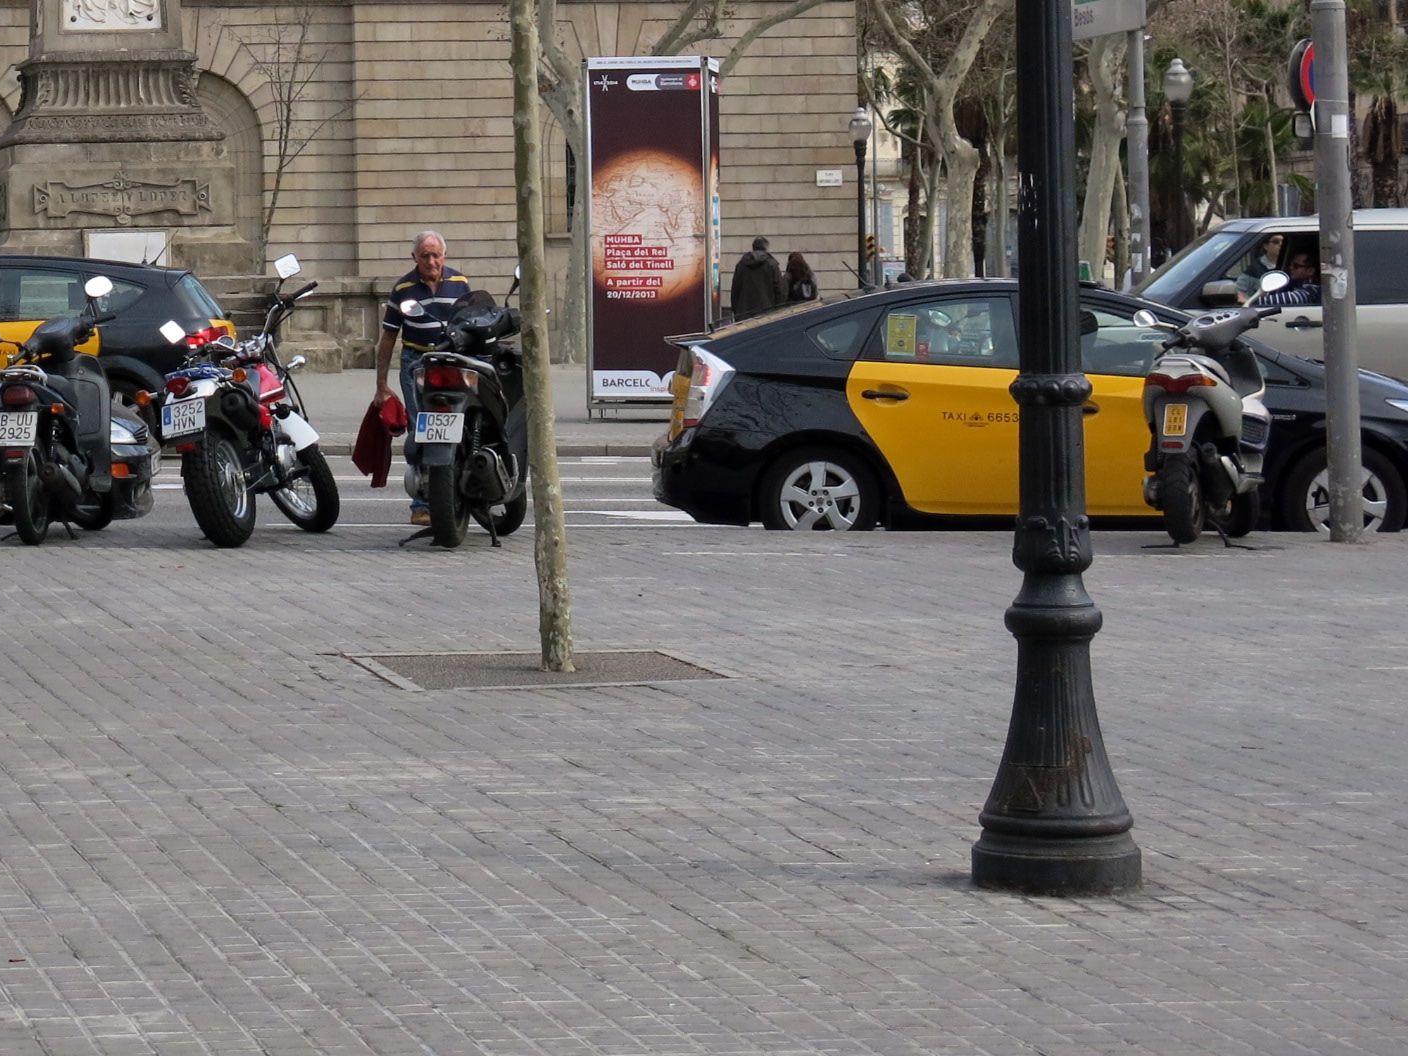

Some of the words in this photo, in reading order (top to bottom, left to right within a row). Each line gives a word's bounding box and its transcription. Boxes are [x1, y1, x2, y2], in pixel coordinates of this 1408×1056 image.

[606, 235, 640, 244] MUHBA
[606, 248, 632, 259] Plaça
[634, 248, 649, 256] del
[652, 248, 666, 256] Rei
[606, 260, 626, 269] Saló
[629, 260, 643, 269] del
[646, 260, 672, 269] Tinell
[607, 278, 614, 286] A
[616, 278, 644, 288] partir
[646, 278, 661, 286] del
[606, 290, 656, 300] 20/12/2013
[173, 400, 203, 419] 3252
[0, 414, 33, 426] B-UU
[427, 414, 457, 427] 0537
[941, 411, 967, 421] TAXI
[173, 415, 196, 432] HVN
[0, 427, 31, 440] 2925
[426, 428, 450, 441] GNL
